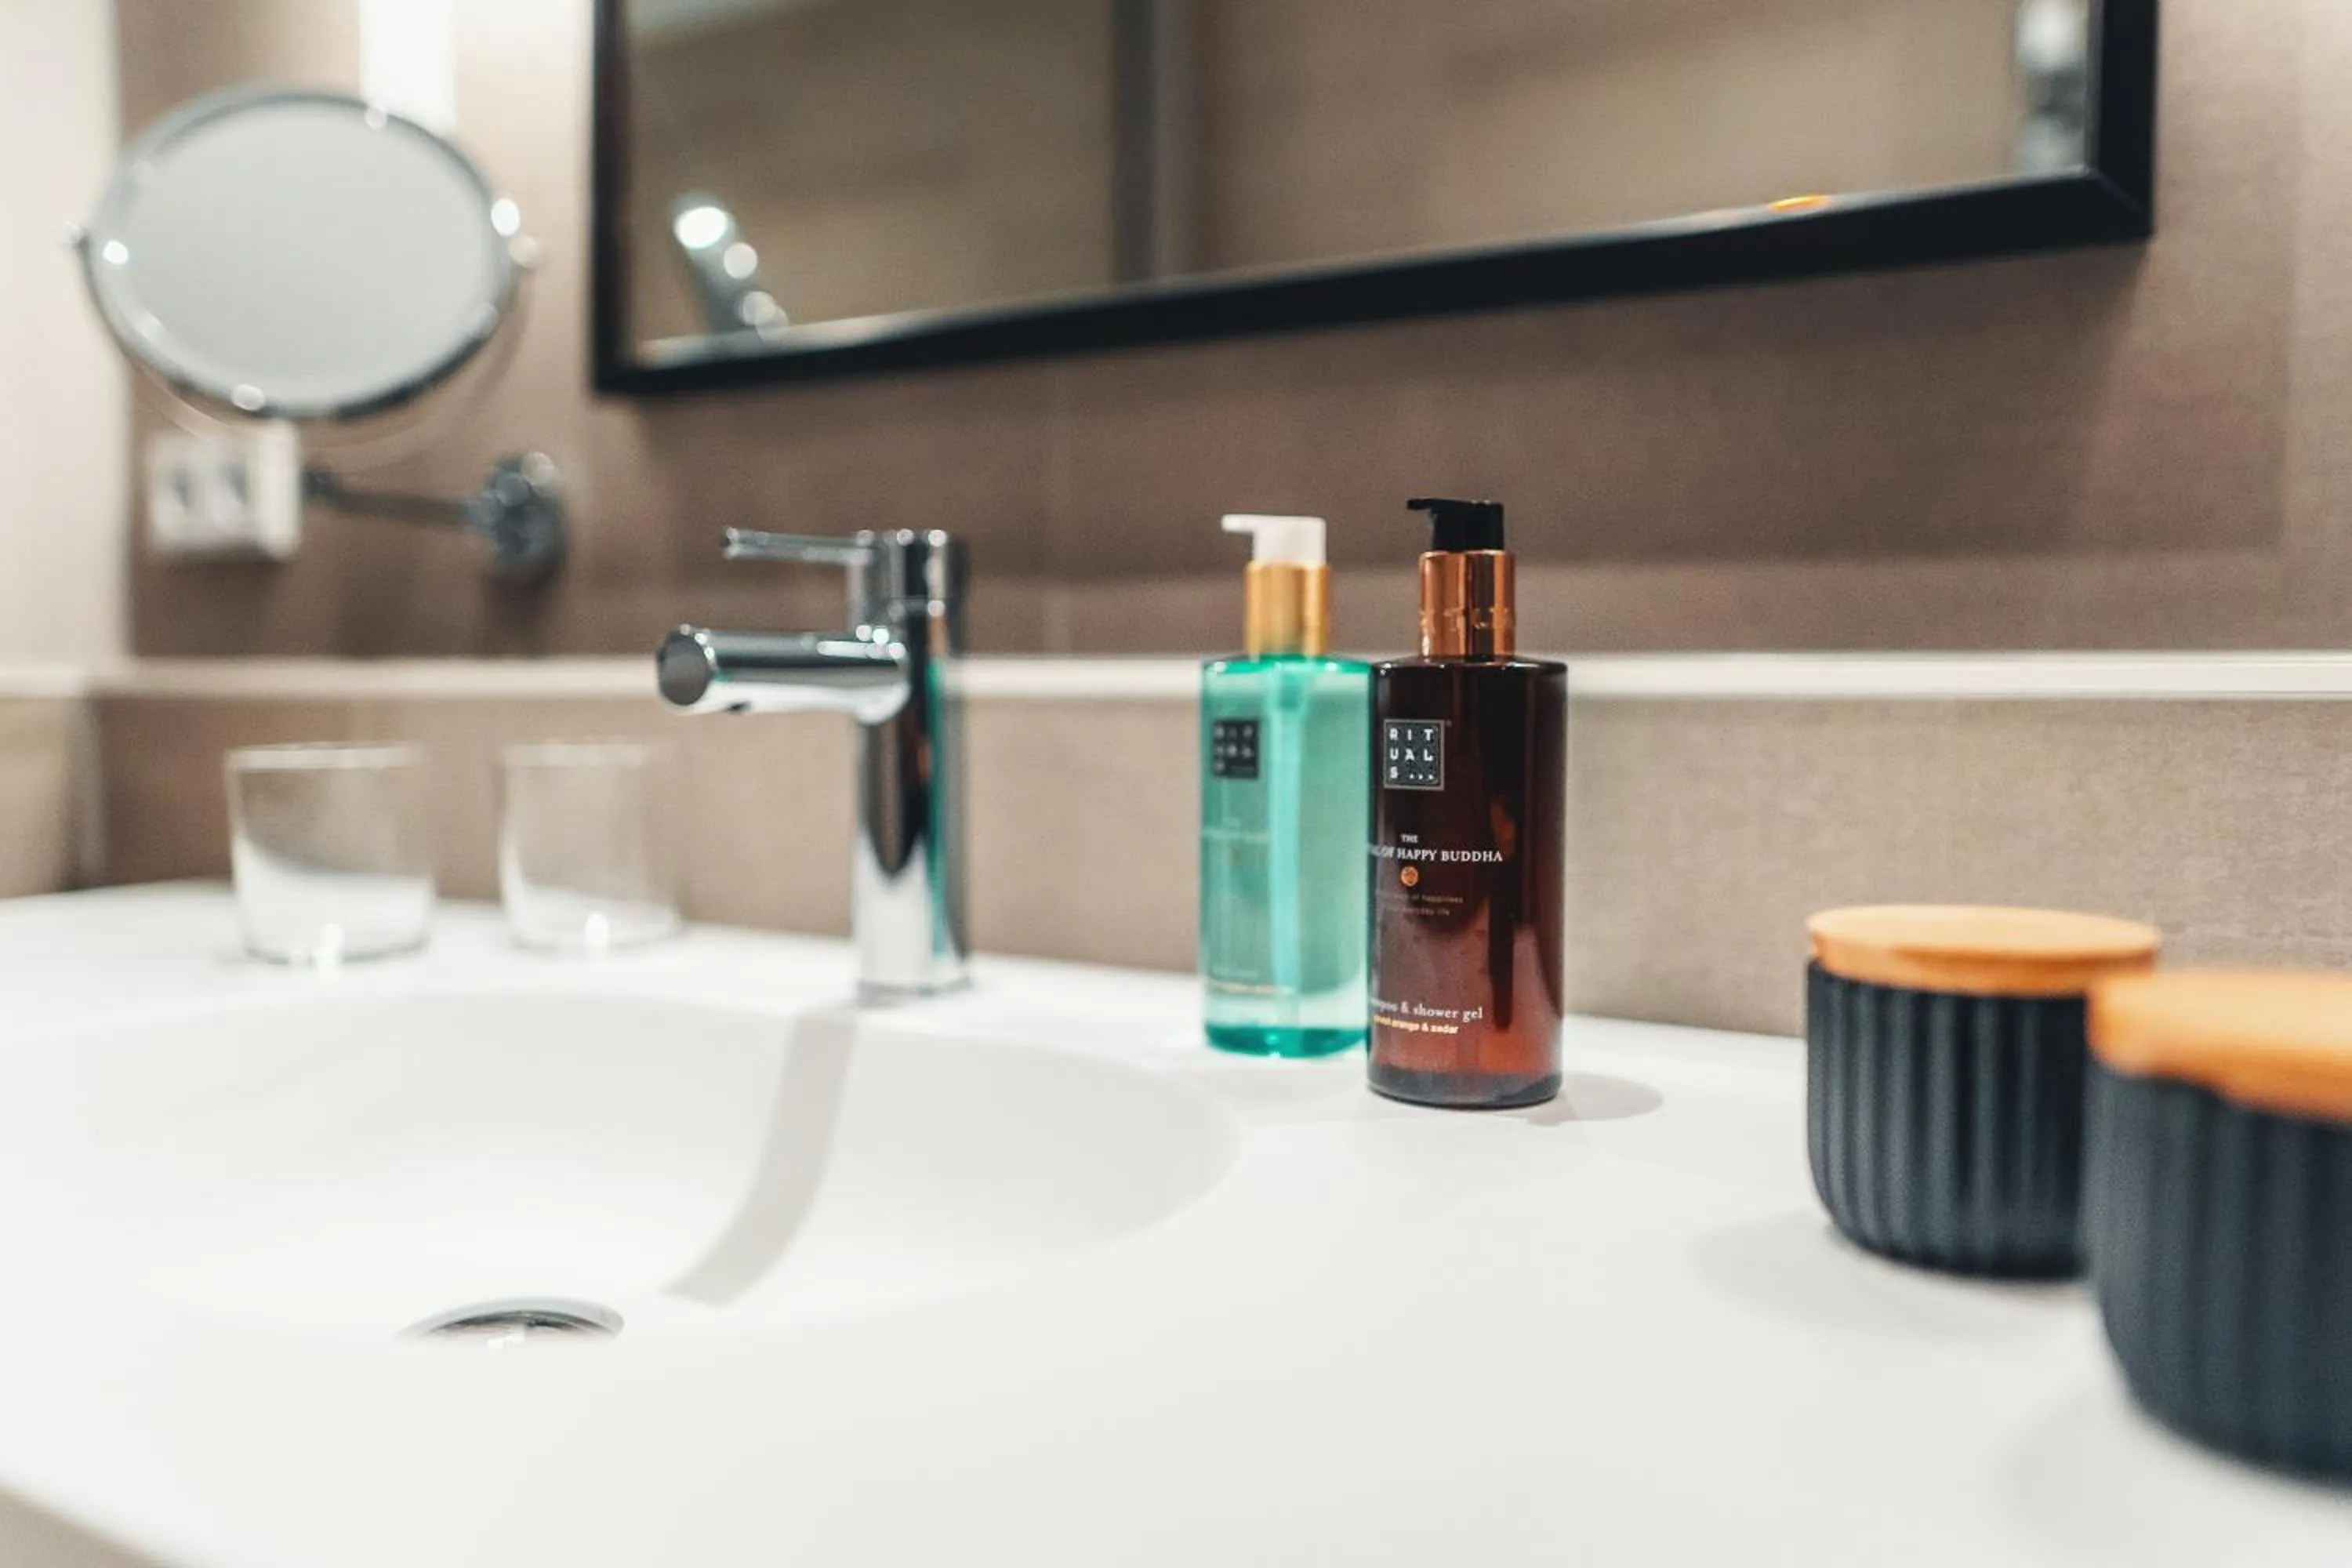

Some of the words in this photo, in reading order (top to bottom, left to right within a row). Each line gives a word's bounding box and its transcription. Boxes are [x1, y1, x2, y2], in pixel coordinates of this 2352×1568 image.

[1400, 833, 1418, 843] THE
[1397, 848, 1437, 861] HAPPY
[1440, 850, 1503, 863] BUDDHA
[1400, 1000, 1409, 1014] &
[1413, 1003, 1458, 1018] shower
[1462, 1006, 1483, 1022] gel
